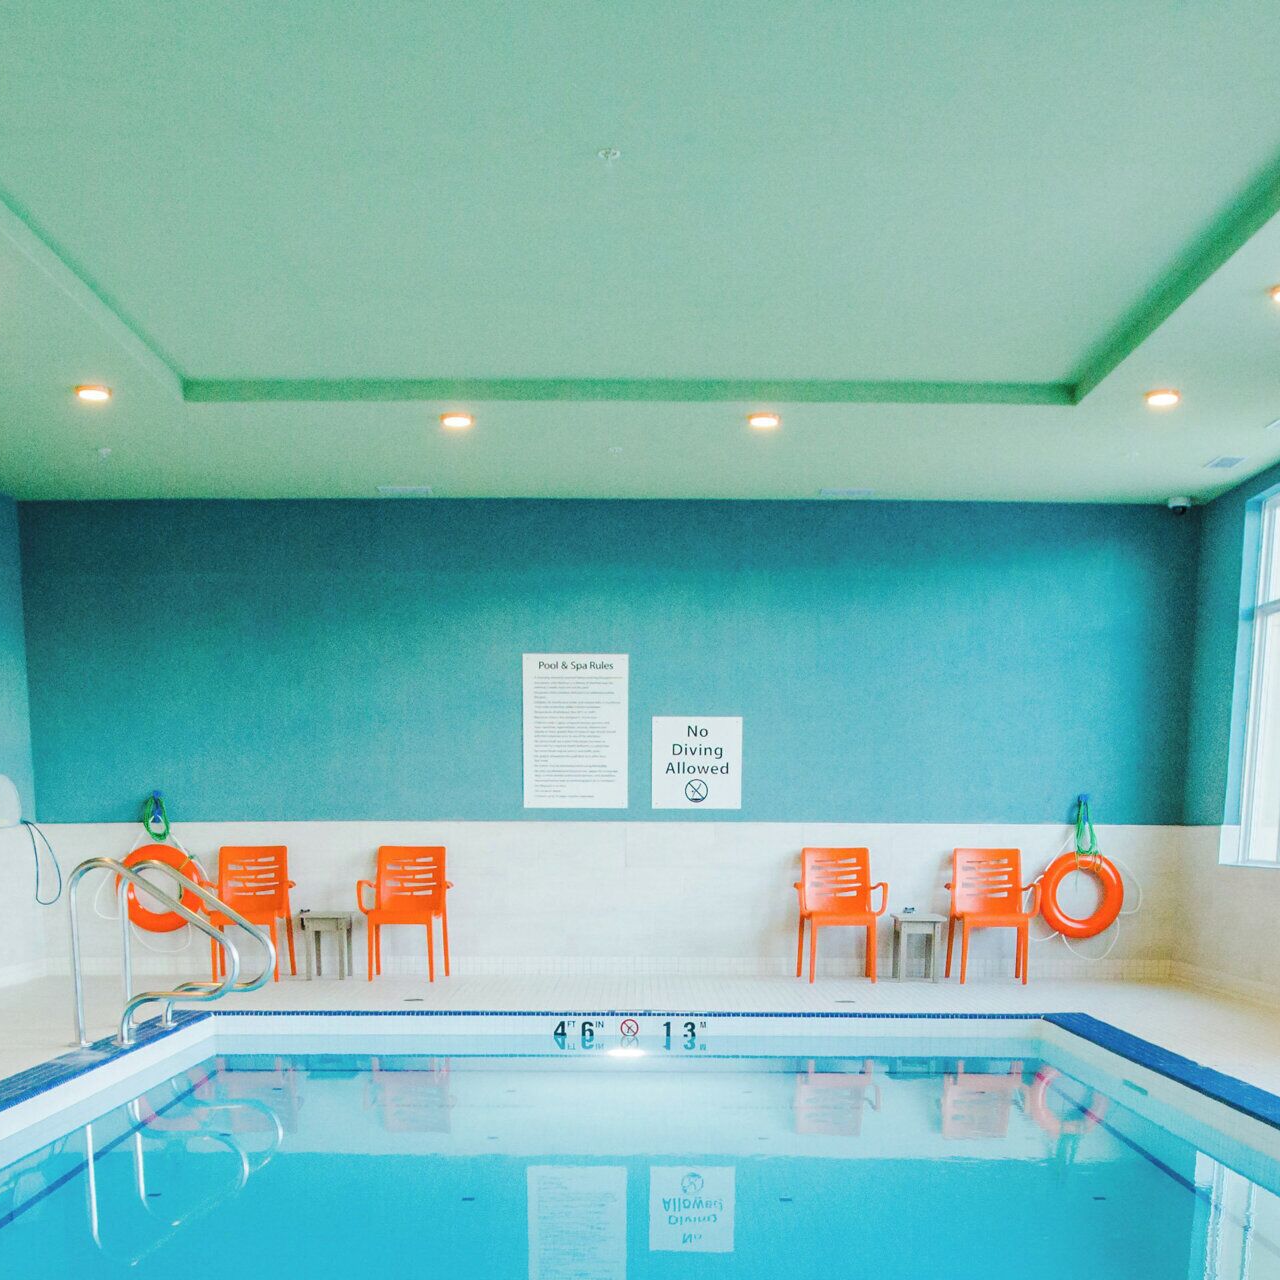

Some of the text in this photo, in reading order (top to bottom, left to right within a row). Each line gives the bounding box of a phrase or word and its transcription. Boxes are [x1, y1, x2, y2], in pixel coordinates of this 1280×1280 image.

[538, 661, 614, 672] Pool & Spa Rules
[687, 725, 708, 738] No
[672, 743, 723, 759] Diving
[665, 761, 729, 775] Allowed
